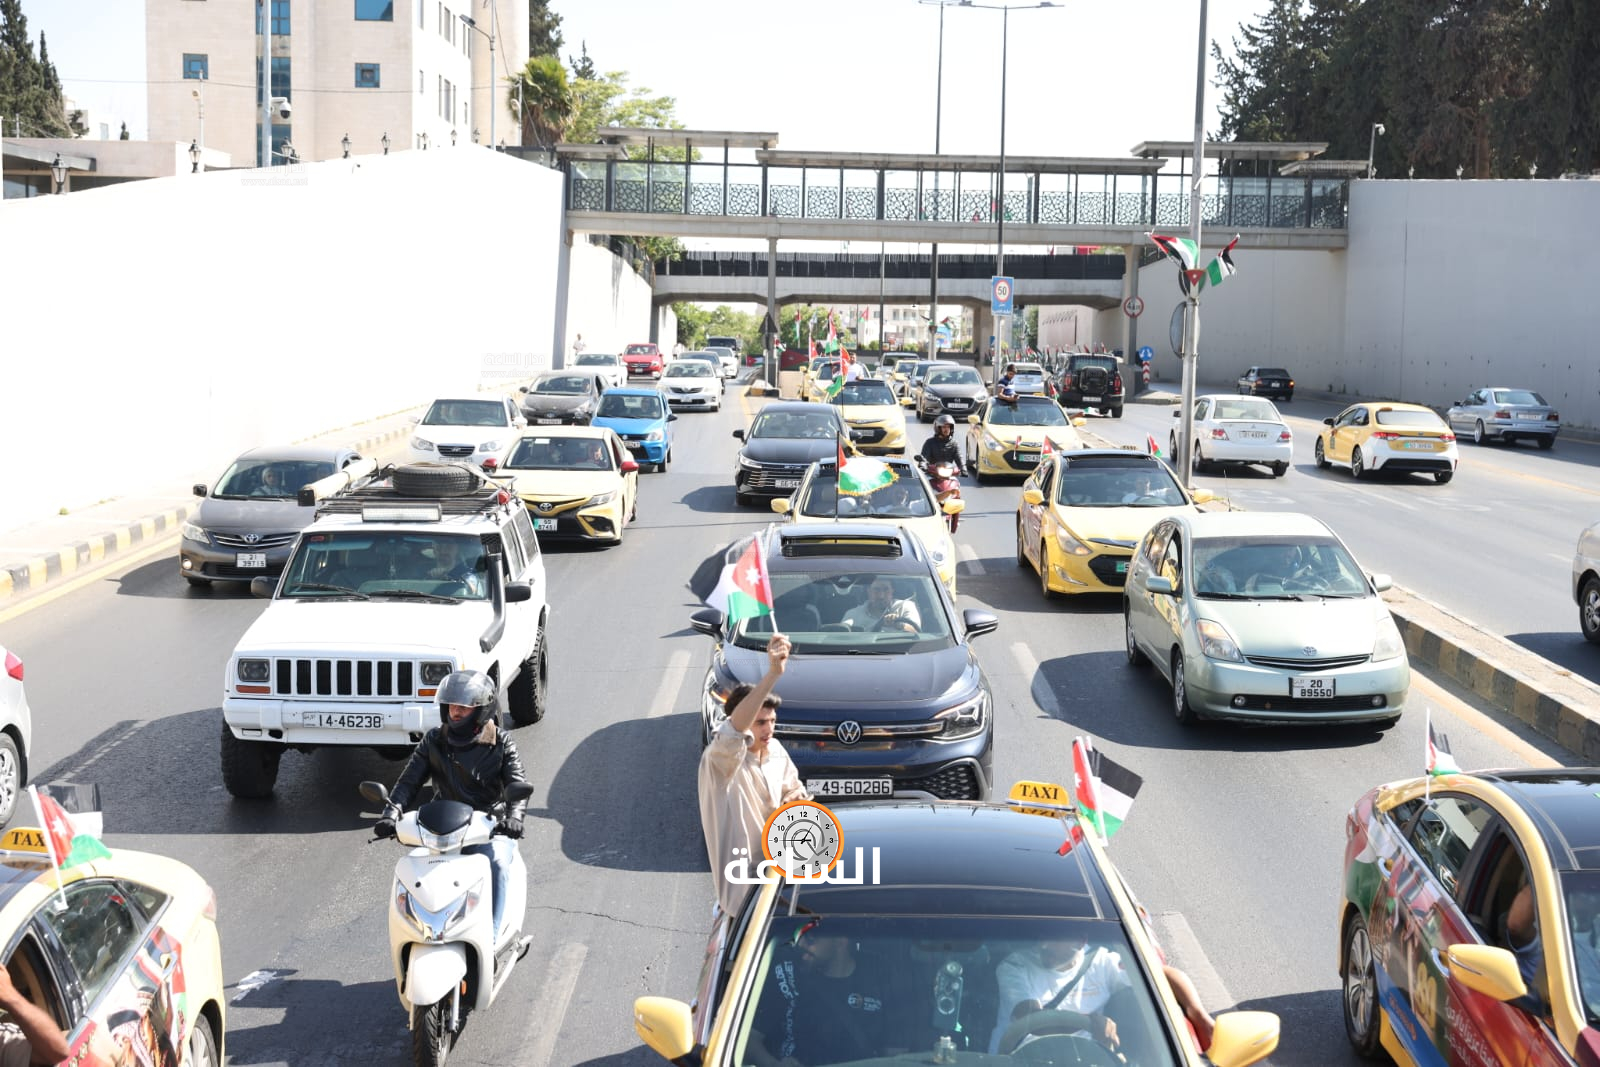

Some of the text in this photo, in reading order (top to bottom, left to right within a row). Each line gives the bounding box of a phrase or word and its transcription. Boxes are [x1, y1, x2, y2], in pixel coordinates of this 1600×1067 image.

[997, 286, 1007, 296] 50
[1310, 679, 1323, 688] 20
[1300, 688, 1332, 697] 89550
[318, 714, 382, 729] 14-46238
[821, 780, 891, 795] 49-60286
[1019, 784, 1059, 801] TAXI
[11, 831, 46, 847] TAX
